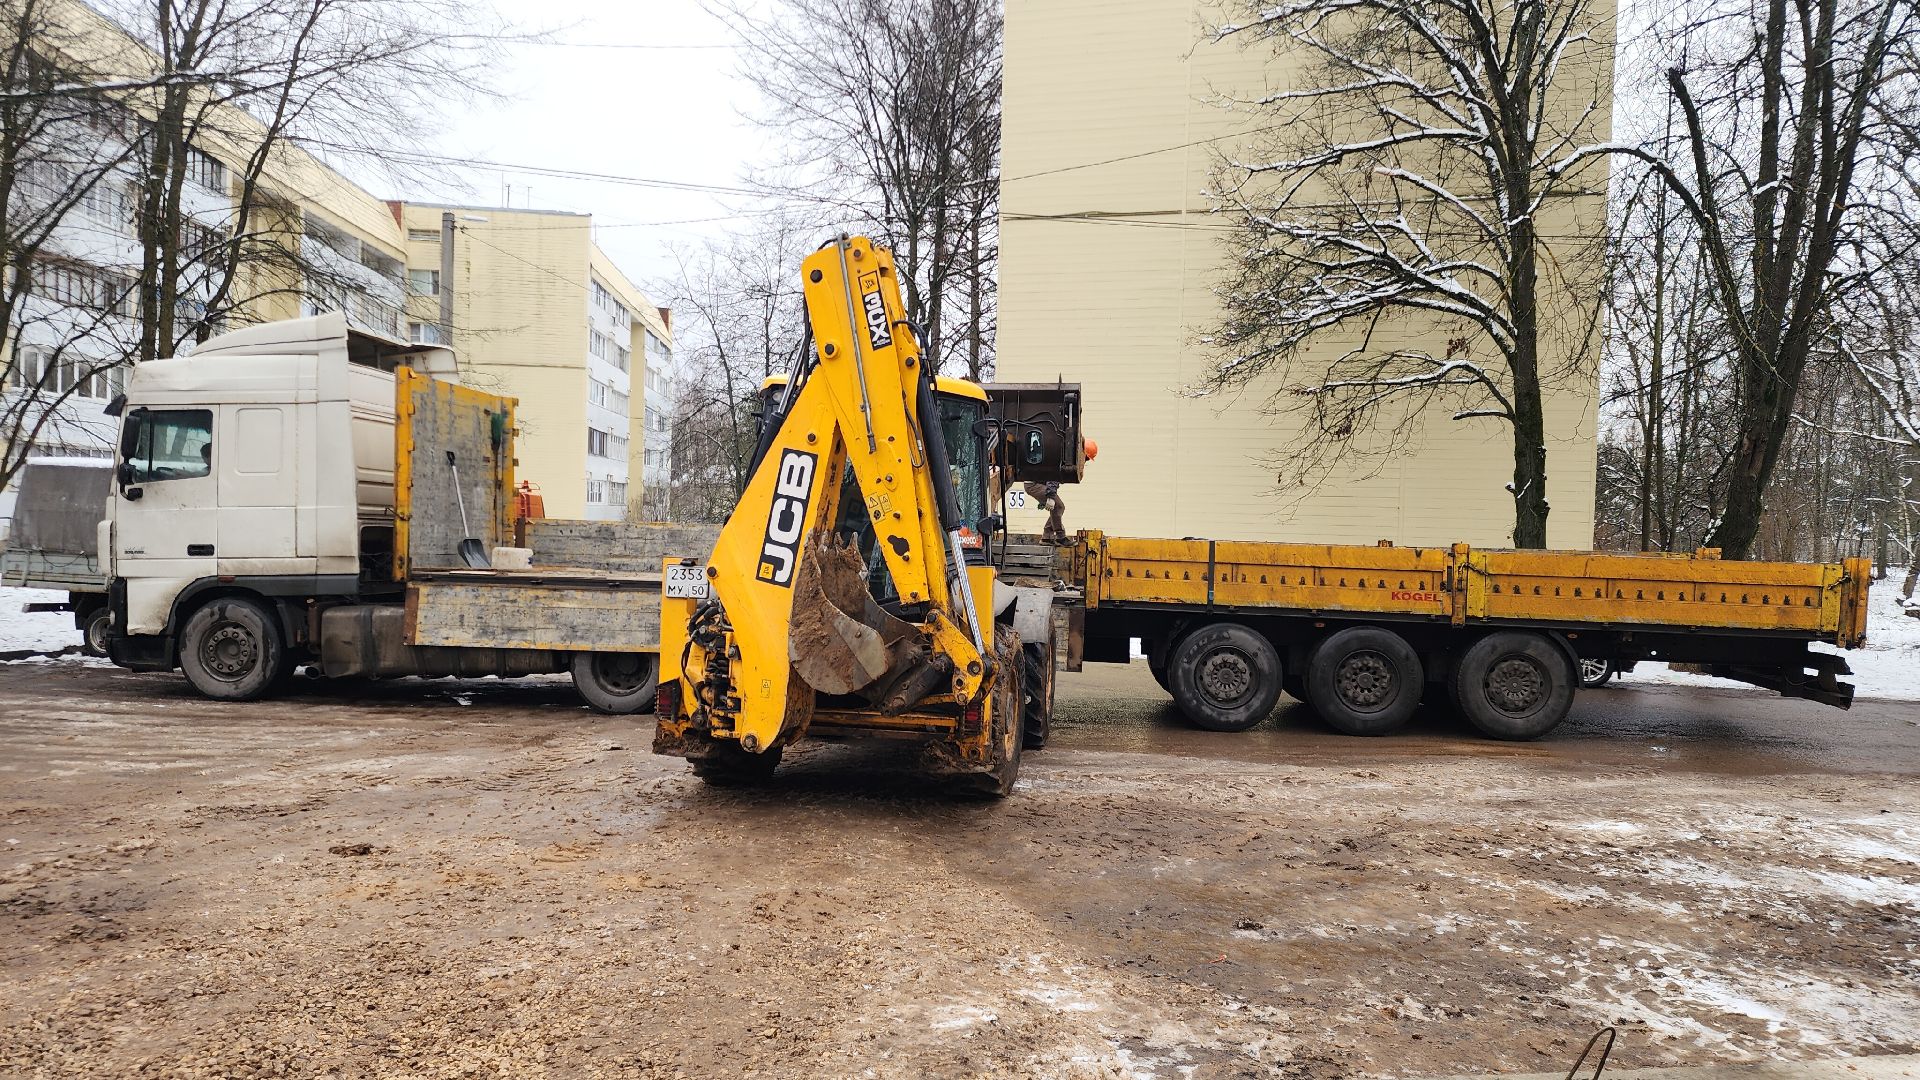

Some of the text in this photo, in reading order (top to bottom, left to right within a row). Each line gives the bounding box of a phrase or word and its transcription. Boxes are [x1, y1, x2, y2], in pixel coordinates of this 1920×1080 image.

[864, 291, 890, 342] 3CX
[1009, 492, 1025, 507] 35
[765, 452, 814, 583] JCB
[671, 568, 703, 581] 2353
[691, 586, 705, 596] 50
